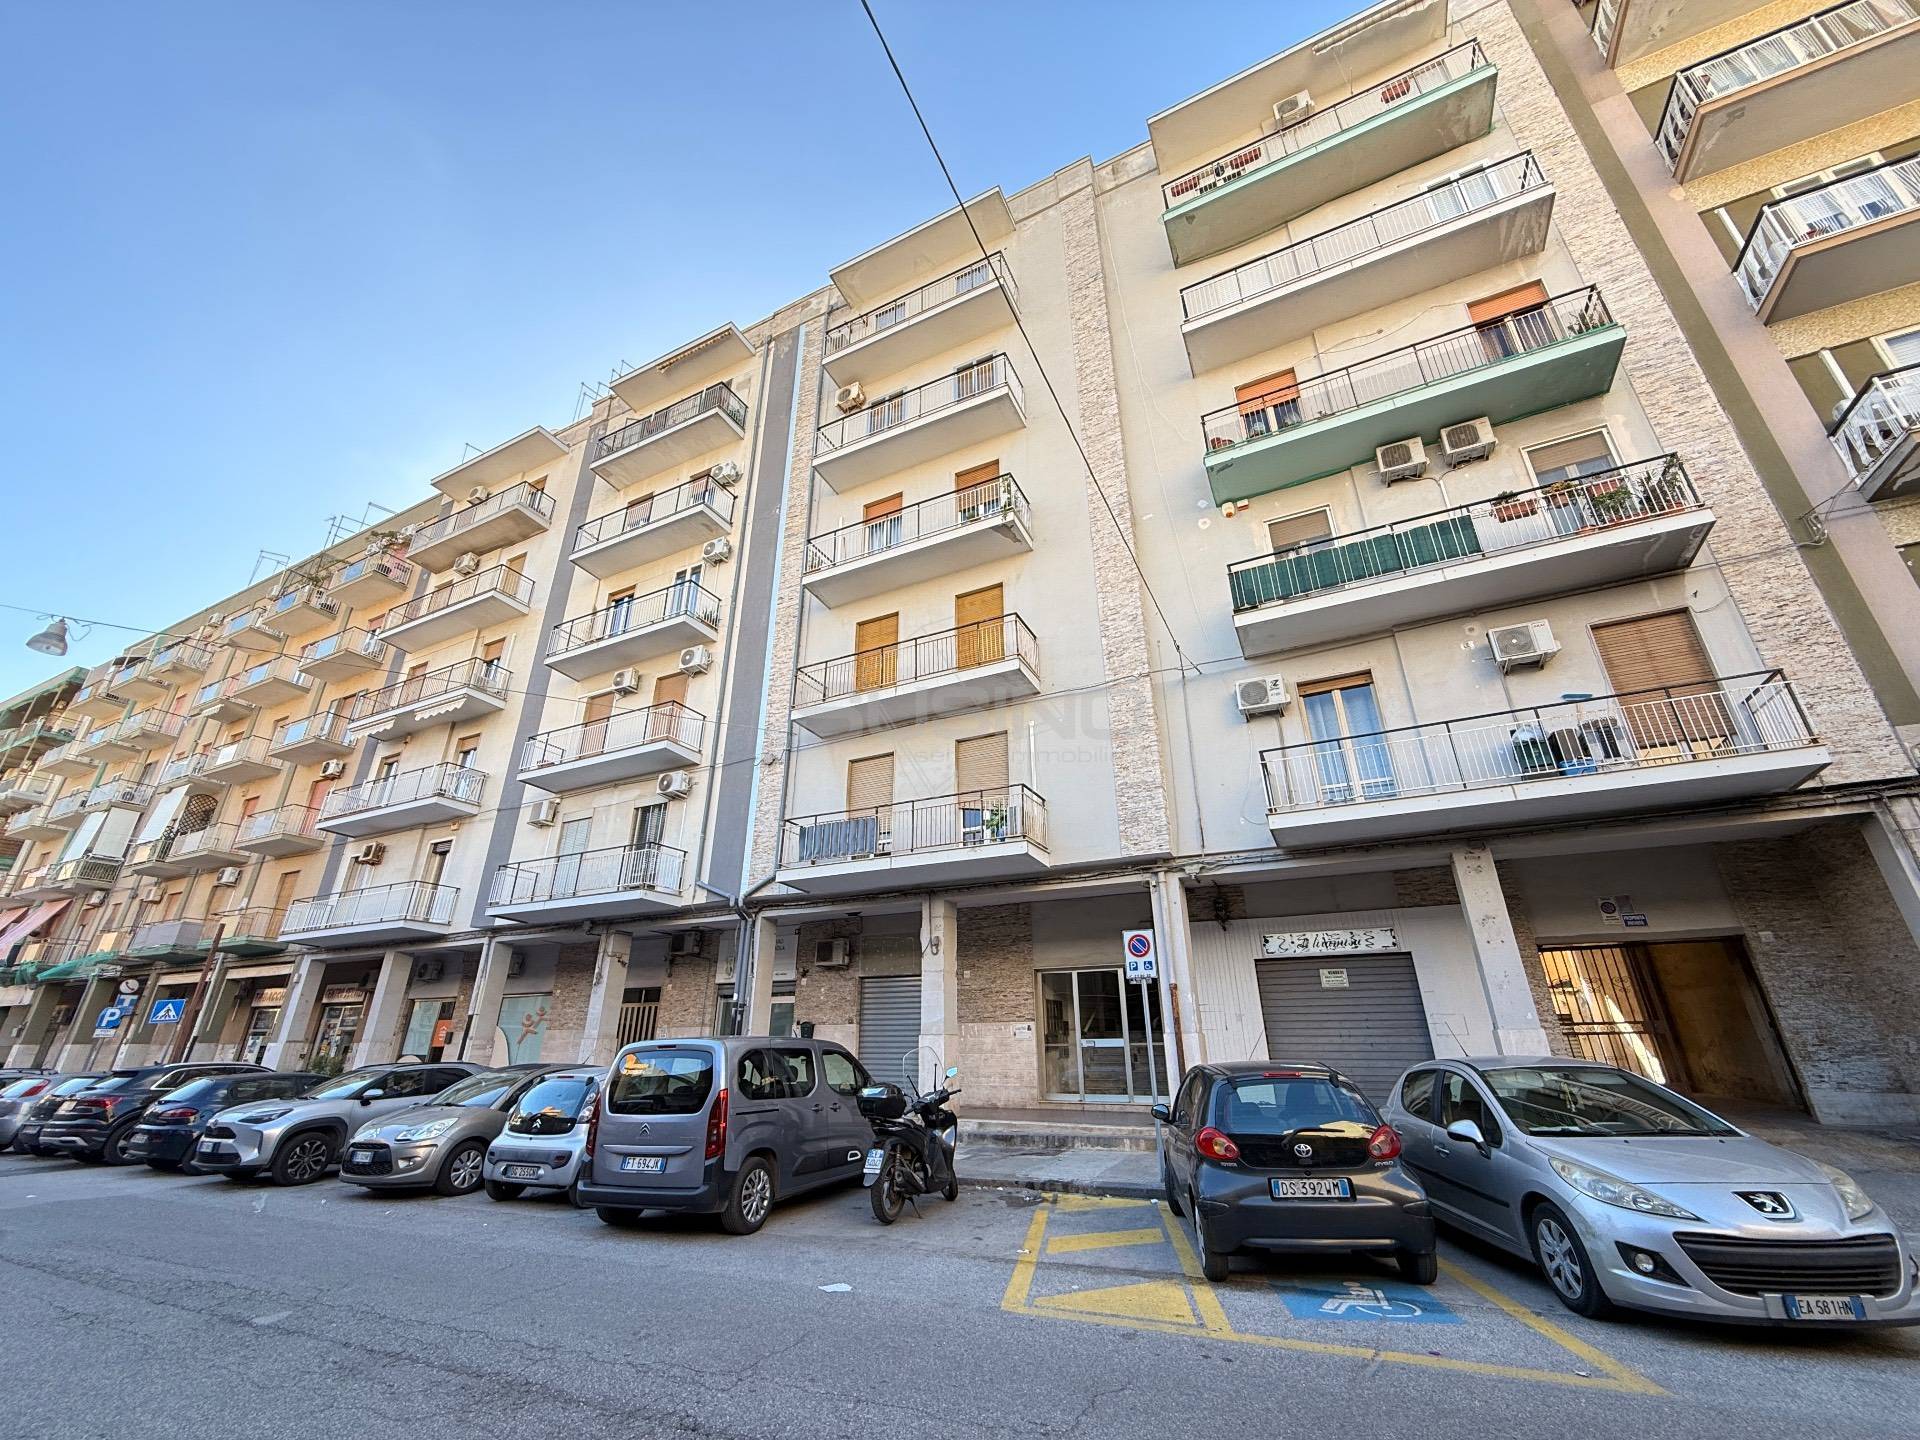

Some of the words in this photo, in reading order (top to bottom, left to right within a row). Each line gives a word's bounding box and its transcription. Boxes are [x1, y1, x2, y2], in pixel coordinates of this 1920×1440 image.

[1130, 962, 1136, 971] P
[101, 1008, 121, 1027] P
[626, 1157, 635, 1168] FT
[1280, 1181, 1297, 1196] DS
[1299, 1181, 1342, 1196] 392WM
[1798, 1299, 1814, 1315] EA
[1815, 1299, 1855, 1316] 581HN
